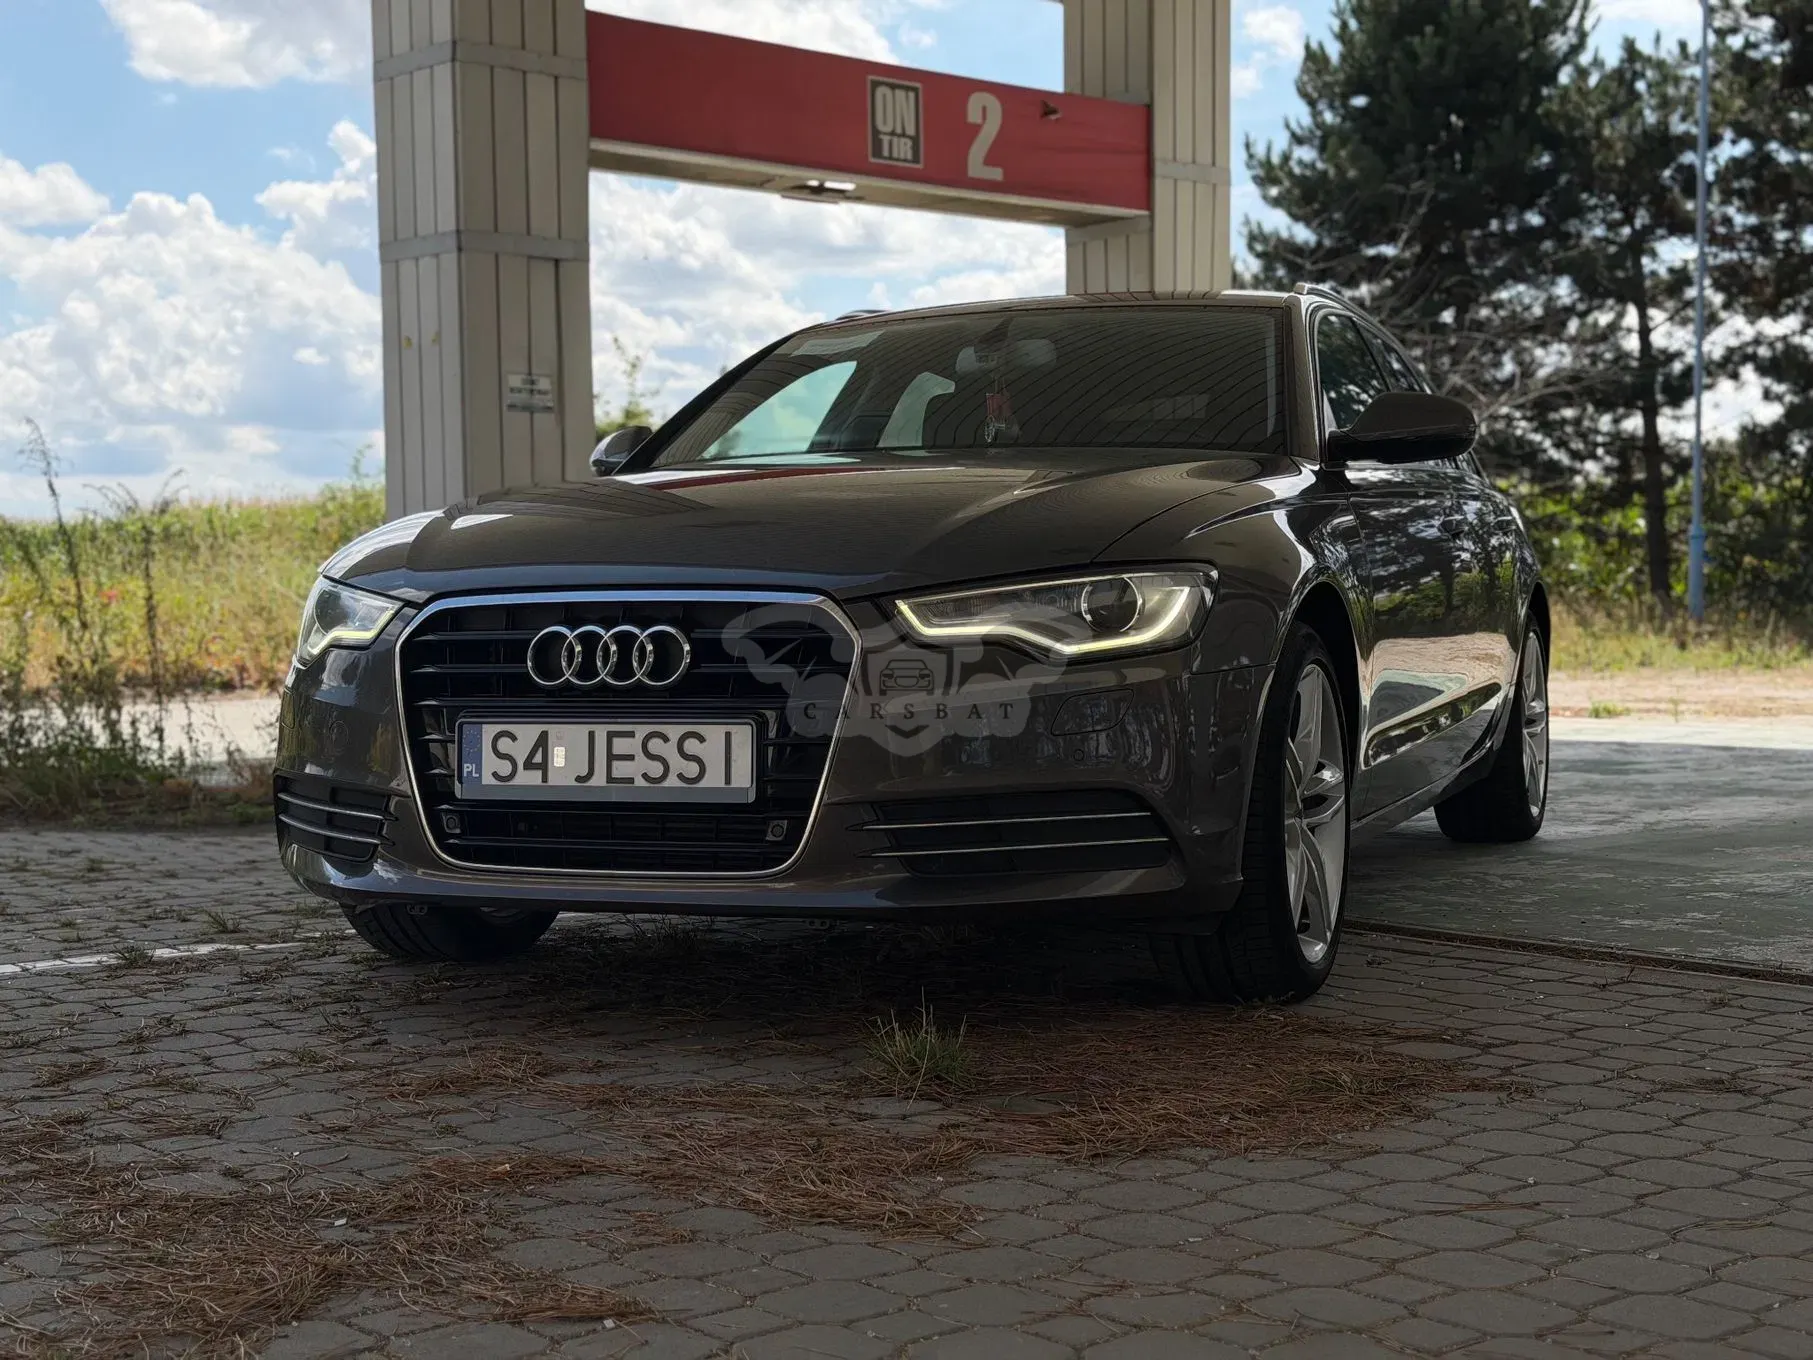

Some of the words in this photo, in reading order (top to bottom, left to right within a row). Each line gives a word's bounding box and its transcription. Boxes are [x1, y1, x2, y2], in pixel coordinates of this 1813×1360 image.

[875, 85, 916, 135] ON
[879, 134, 914, 160] TIR
[966, 91, 1003, 180] 2
[463, 763, 480, 778] PL
[491, 730, 549, 784] S4
